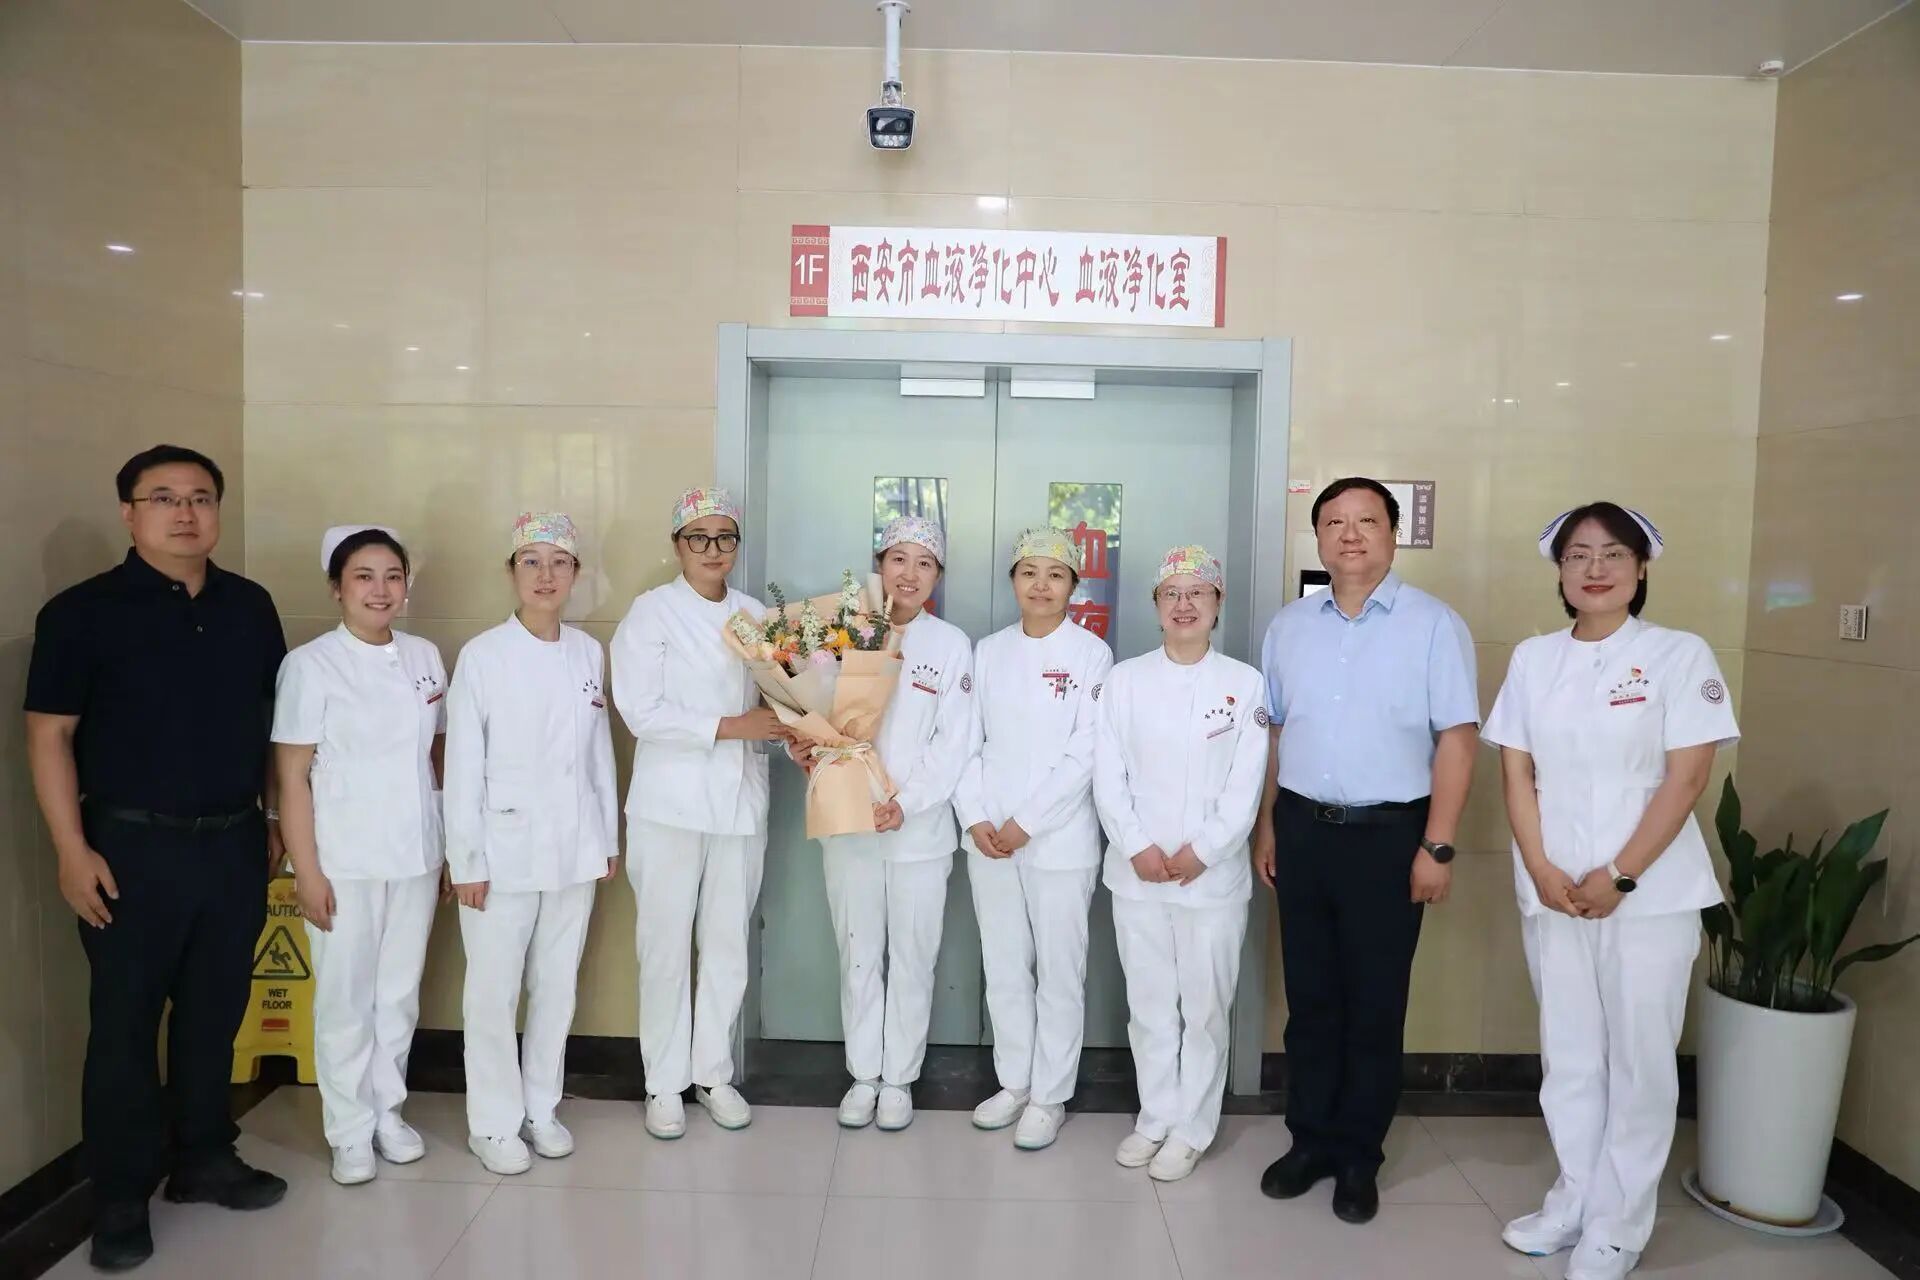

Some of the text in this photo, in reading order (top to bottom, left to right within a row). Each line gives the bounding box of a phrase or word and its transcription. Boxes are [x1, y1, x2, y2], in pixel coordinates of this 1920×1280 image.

[794, 237, 1191, 313] 1F 西安市血液净化中心 血液净化室
[268, 988, 288, 998] WET
[262, 1000, 292, 1010] FLOOR
